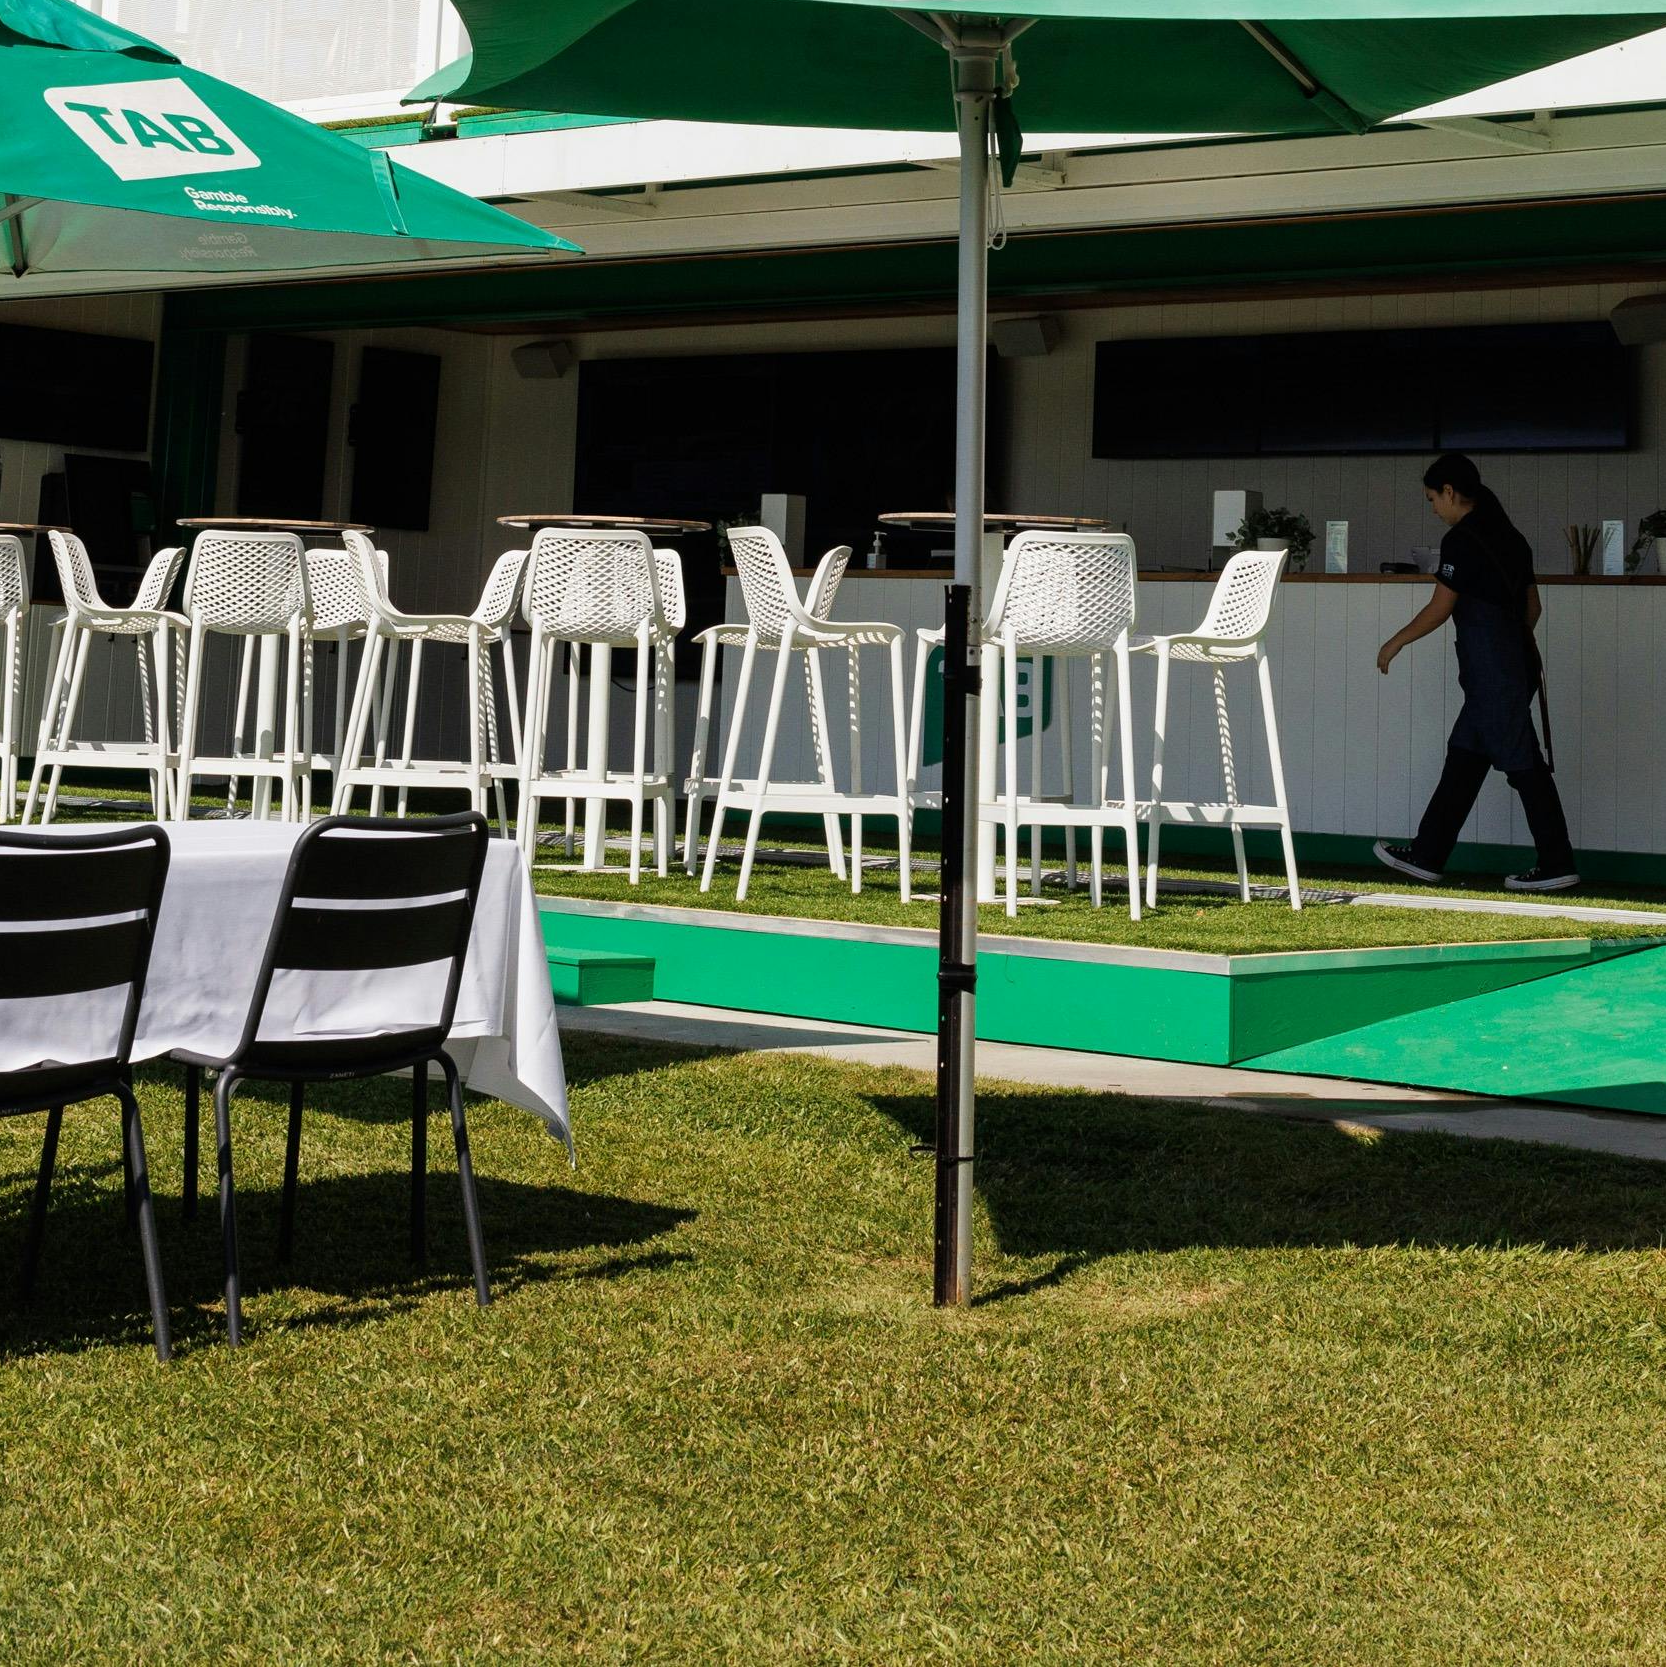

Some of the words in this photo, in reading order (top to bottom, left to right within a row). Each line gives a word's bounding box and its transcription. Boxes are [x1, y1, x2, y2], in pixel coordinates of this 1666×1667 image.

[63, 101, 236, 157] TAB
[184, 186, 250, 204] Gamble
[195, 199, 298, 219] Responsibly.
